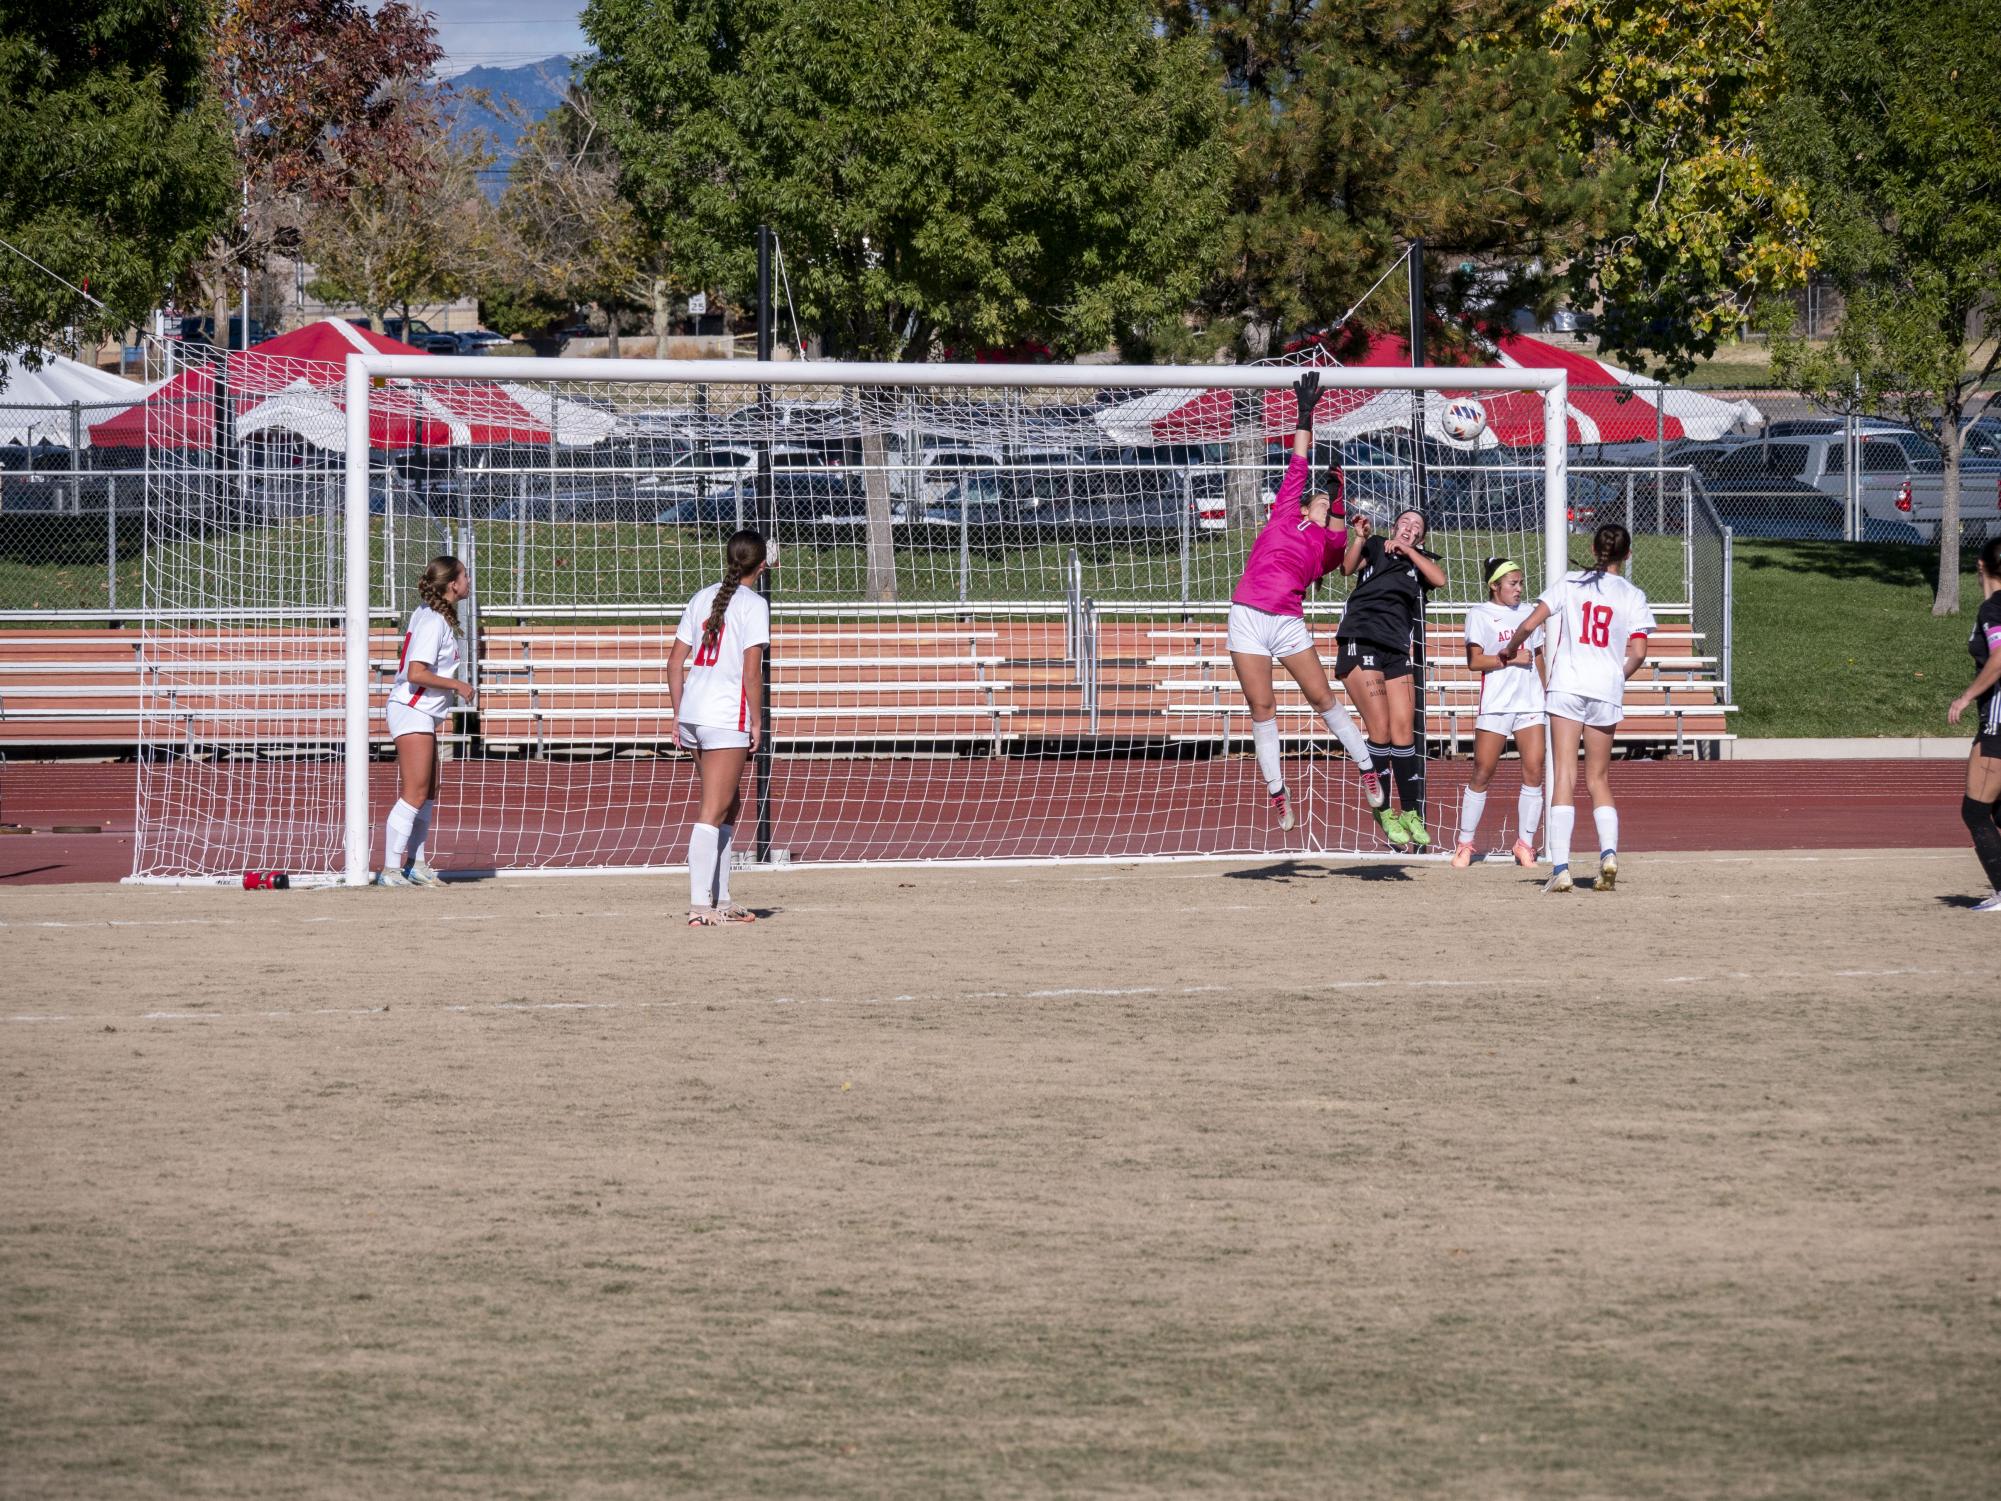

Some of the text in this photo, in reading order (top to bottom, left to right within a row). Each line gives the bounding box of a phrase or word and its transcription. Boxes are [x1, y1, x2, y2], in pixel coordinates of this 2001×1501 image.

[691, 302, 705, 311] 25
[1579, 601, 1613, 648] 18
[1362, 655, 1375, 666] H
